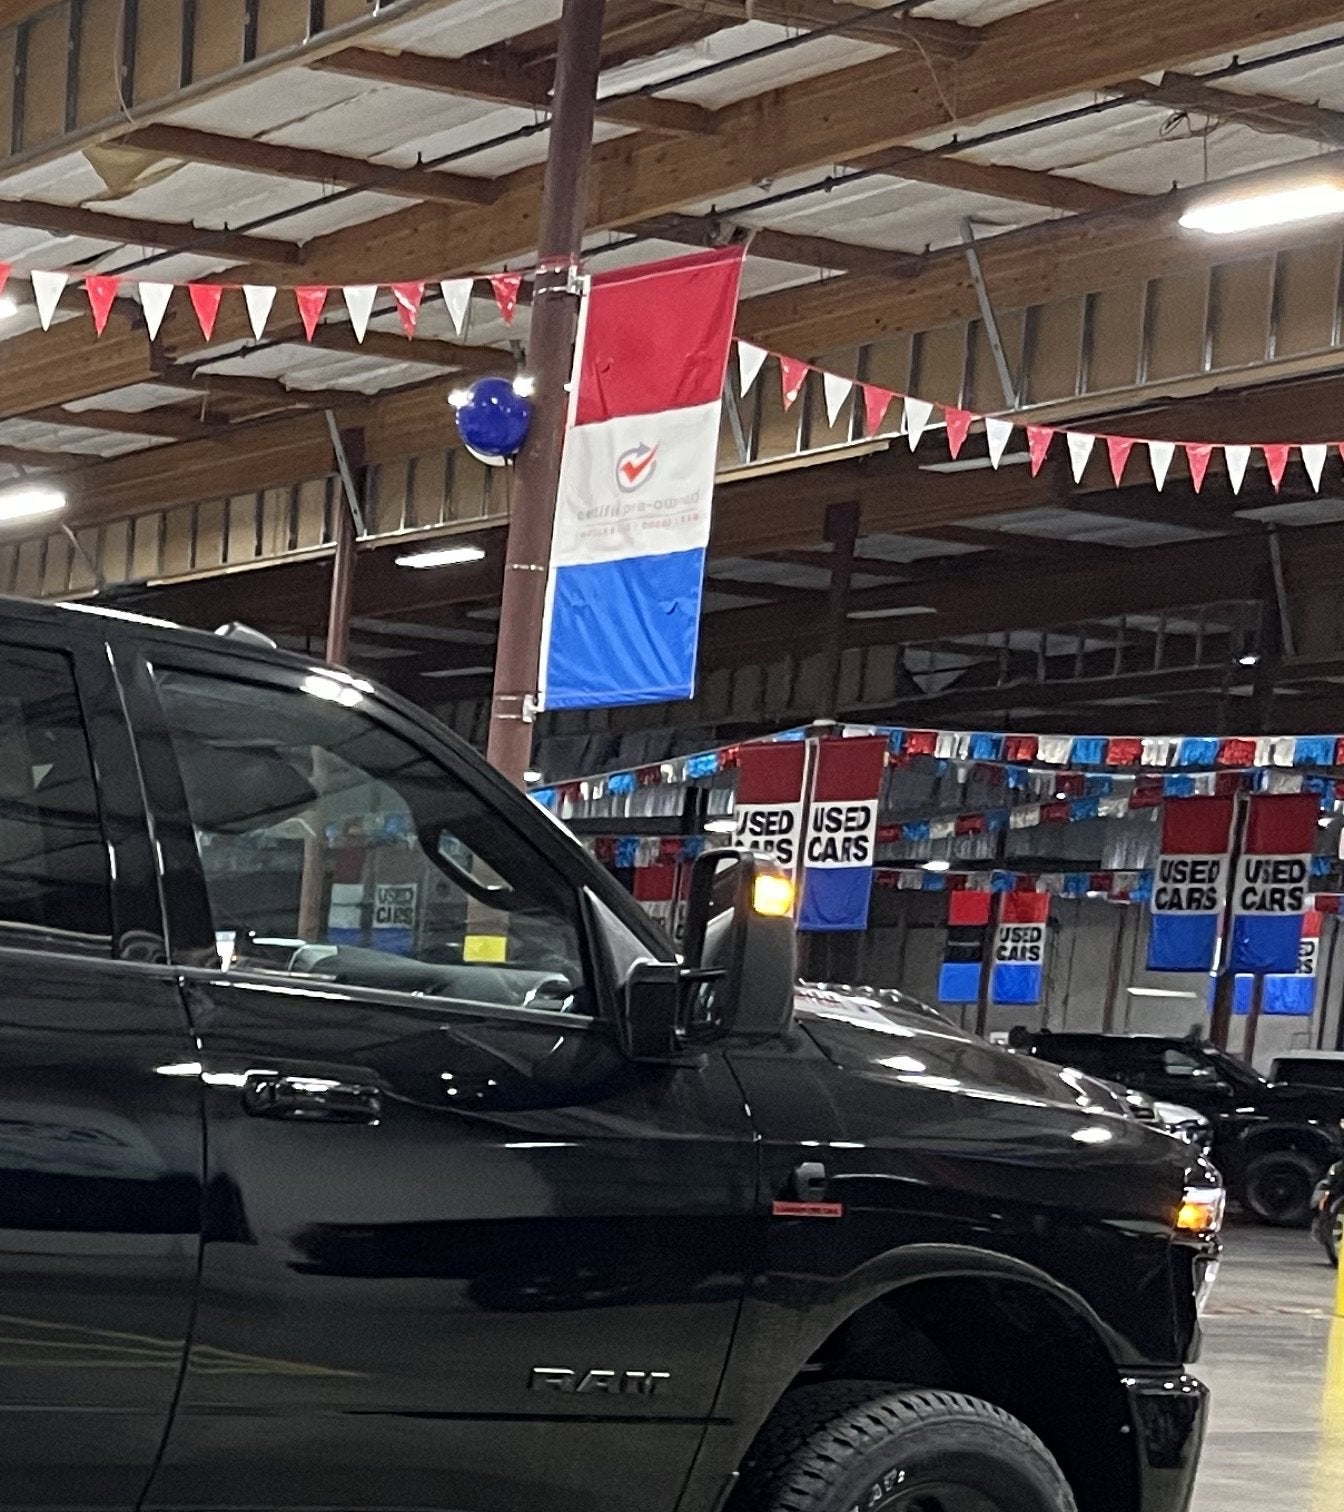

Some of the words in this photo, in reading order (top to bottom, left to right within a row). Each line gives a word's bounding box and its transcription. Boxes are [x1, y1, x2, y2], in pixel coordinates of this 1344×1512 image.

[813, 806, 871, 834] USED
[807, 835, 869, 863] CARS
[1160, 860, 1220, 884] USED
[1155, 886, 1217, 911] CARS
[528, 1367, 671, 1395] RAM
